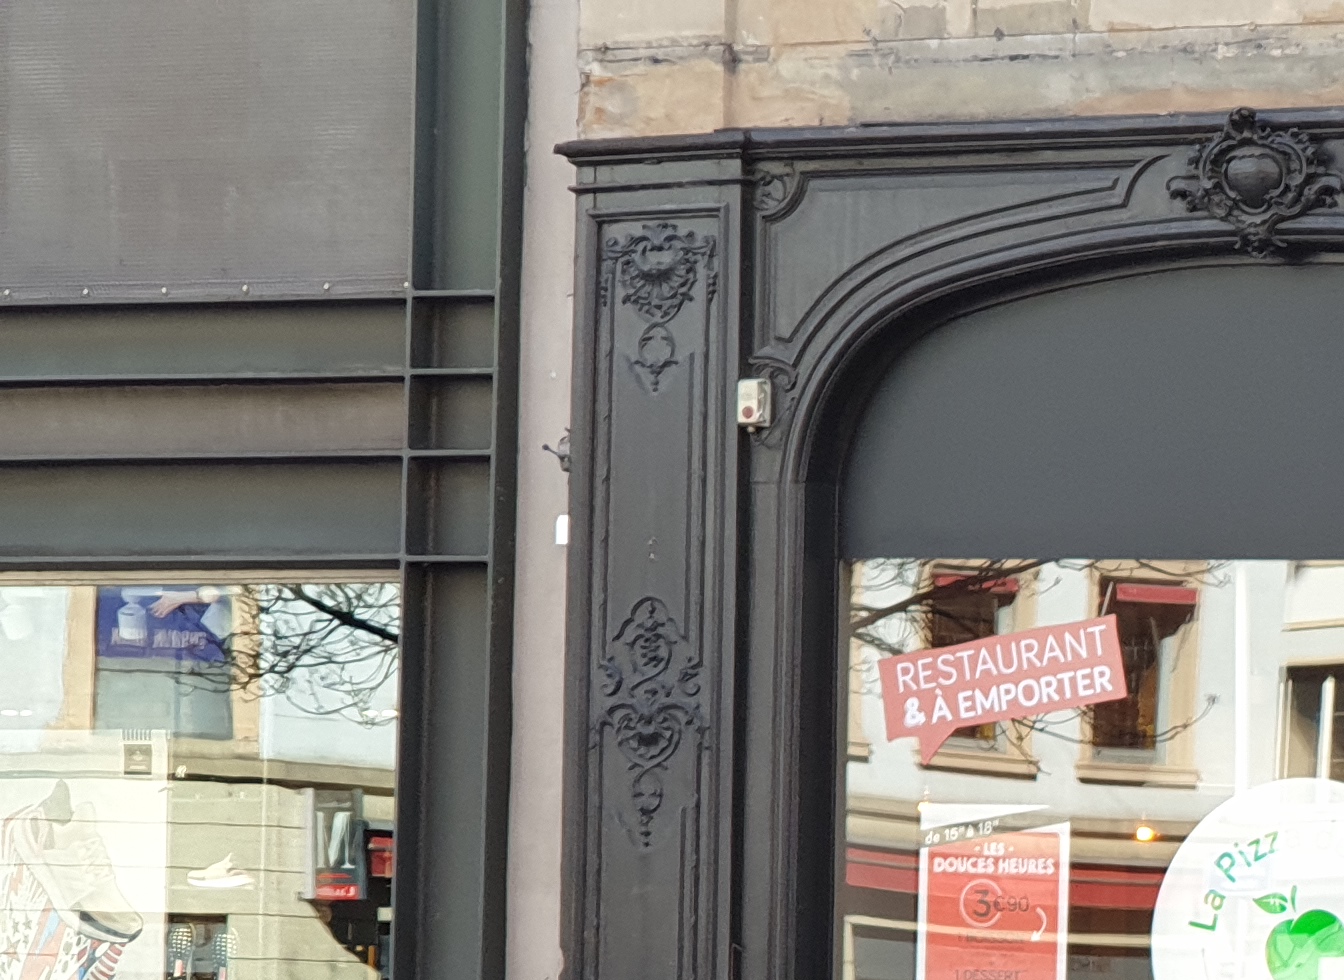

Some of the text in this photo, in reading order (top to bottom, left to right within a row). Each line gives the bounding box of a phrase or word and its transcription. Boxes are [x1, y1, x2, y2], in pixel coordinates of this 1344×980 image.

[897, 625, 1106, 693] RESTAURANT
[904, 665, 1112, 728] & À EMPORTER
[933, 857, 1055, 875] DOUCES HEURES
[983, 842, 1005, 856] LES
[973, 889, 1030, 918] 3€90
[1188, 889, 1226, 931] La
